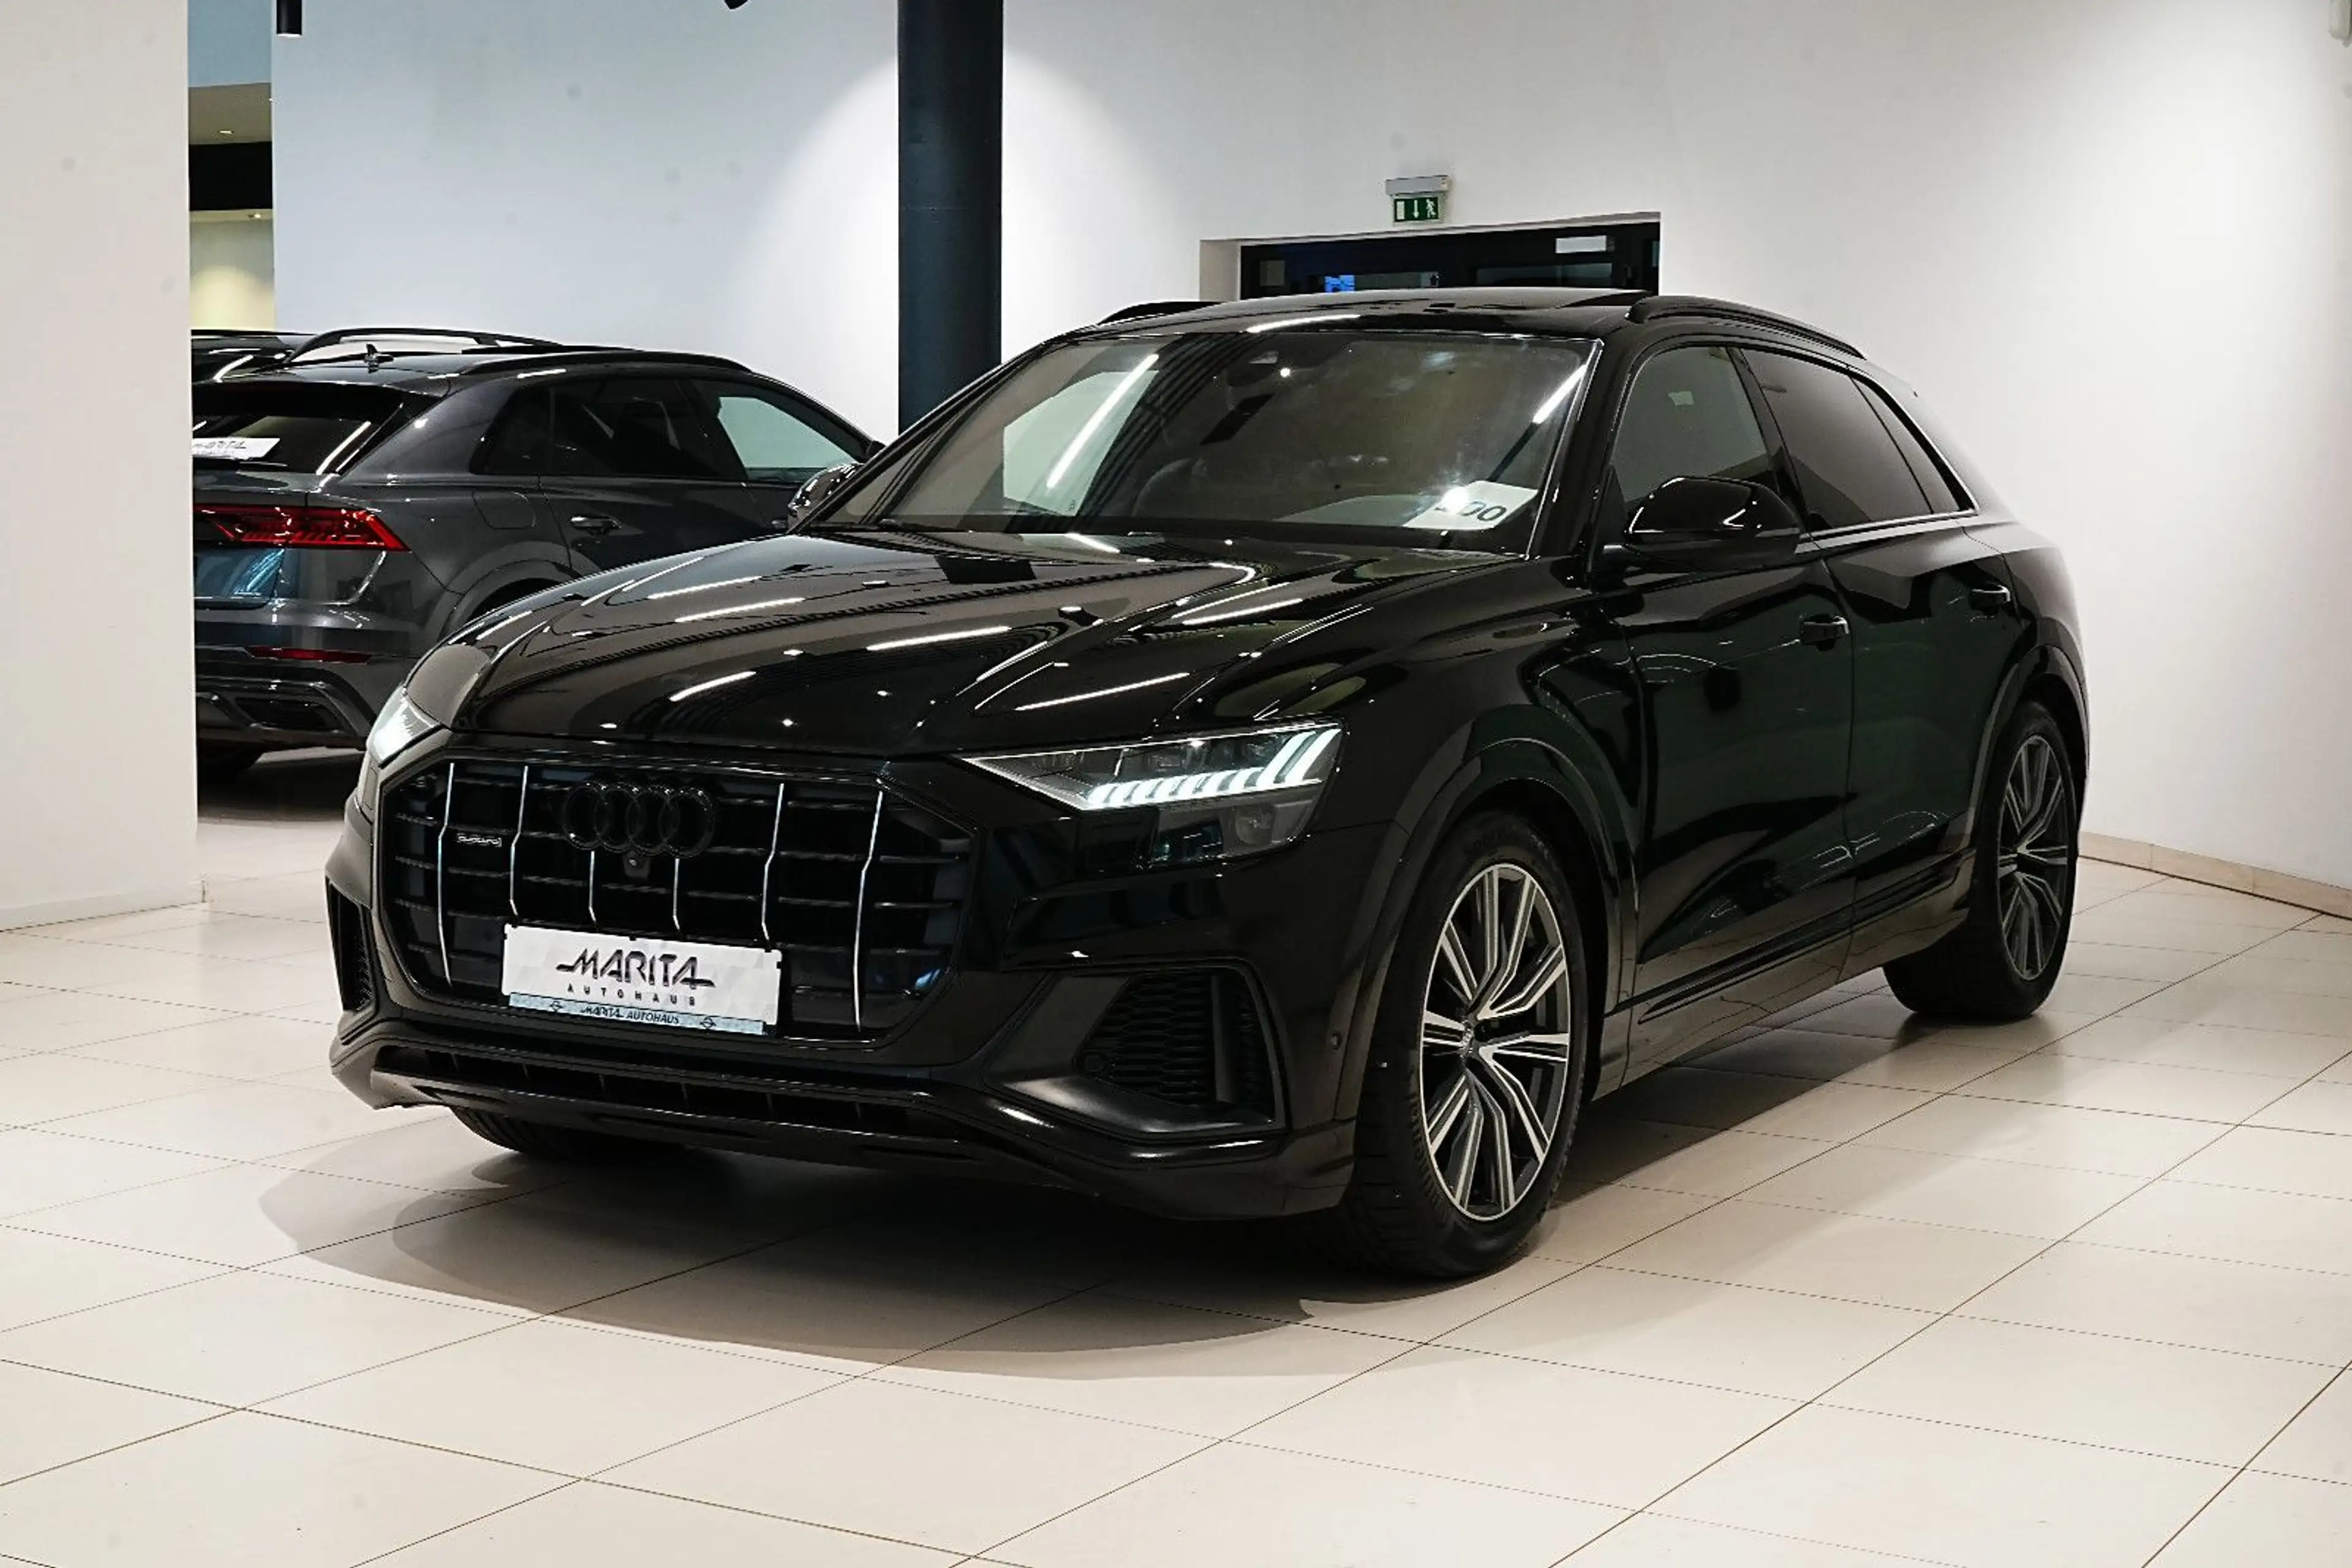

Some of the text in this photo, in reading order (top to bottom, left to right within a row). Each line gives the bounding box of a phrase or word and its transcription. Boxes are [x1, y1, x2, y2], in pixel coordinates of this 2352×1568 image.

[556, 948, 715, 990] MARITA
[567, 983, 695, 1006] AUTOHAUS
[581, 1006, 680, 1025] MARITA AUTOHAUS
